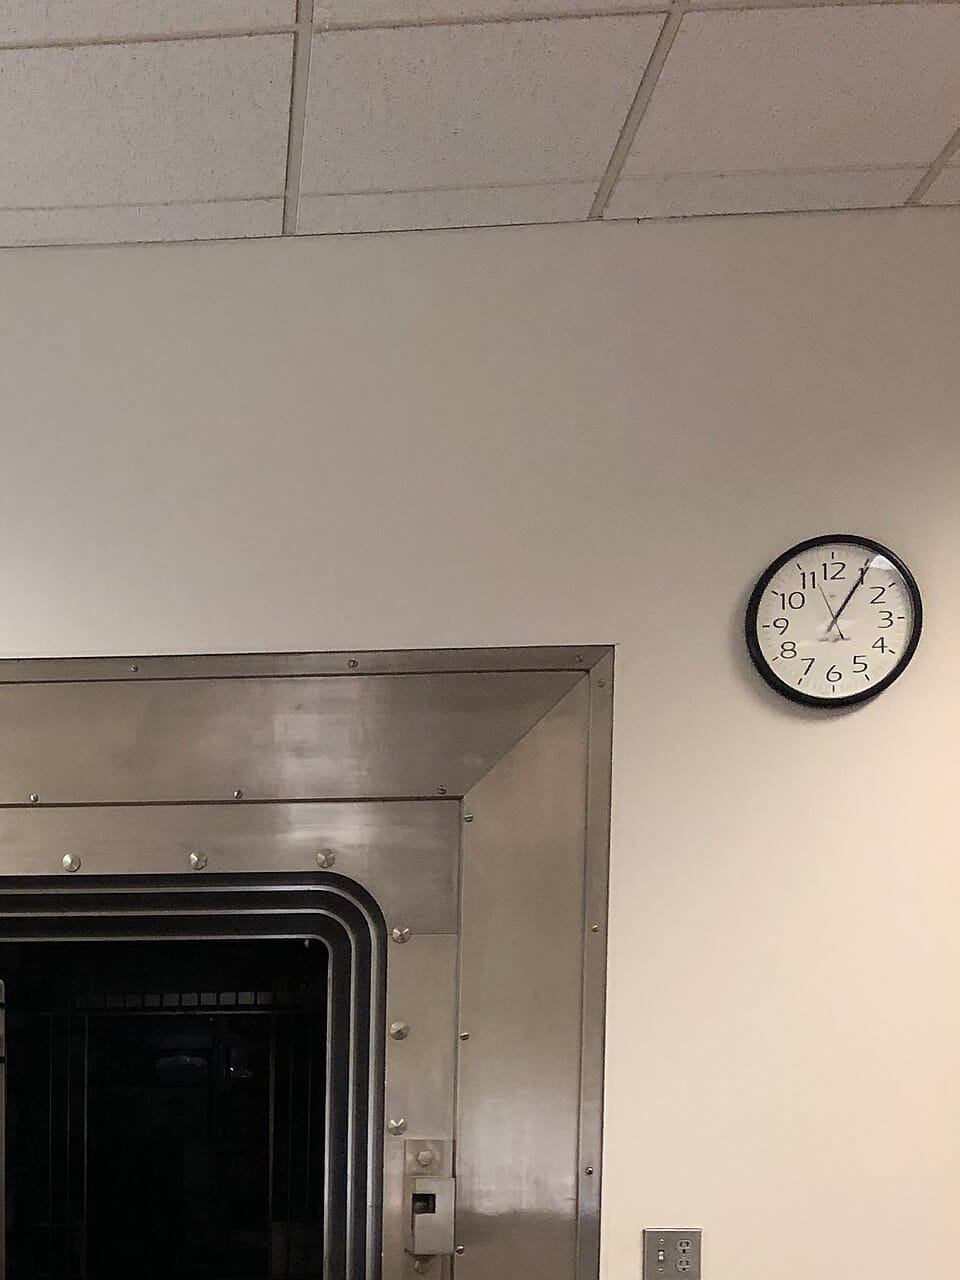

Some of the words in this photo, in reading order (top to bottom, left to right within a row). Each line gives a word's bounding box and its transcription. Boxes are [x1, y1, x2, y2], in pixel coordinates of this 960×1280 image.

[800, 572, 816, 589] 11
[822, 562, 846, 581] 12
[780, 591, 806, 611] 10
[870, 586, 886, 604] 2
[773, 617, 789, 635] 9
[878, 610, 893, 628] 3
[780, 641, 797, 659] 8
[871, 636, 888, 654] 4
[801, 658, 816, 676] 7
[852, 655, 868, 673] 5
[826, 664, 842, 683] 6
